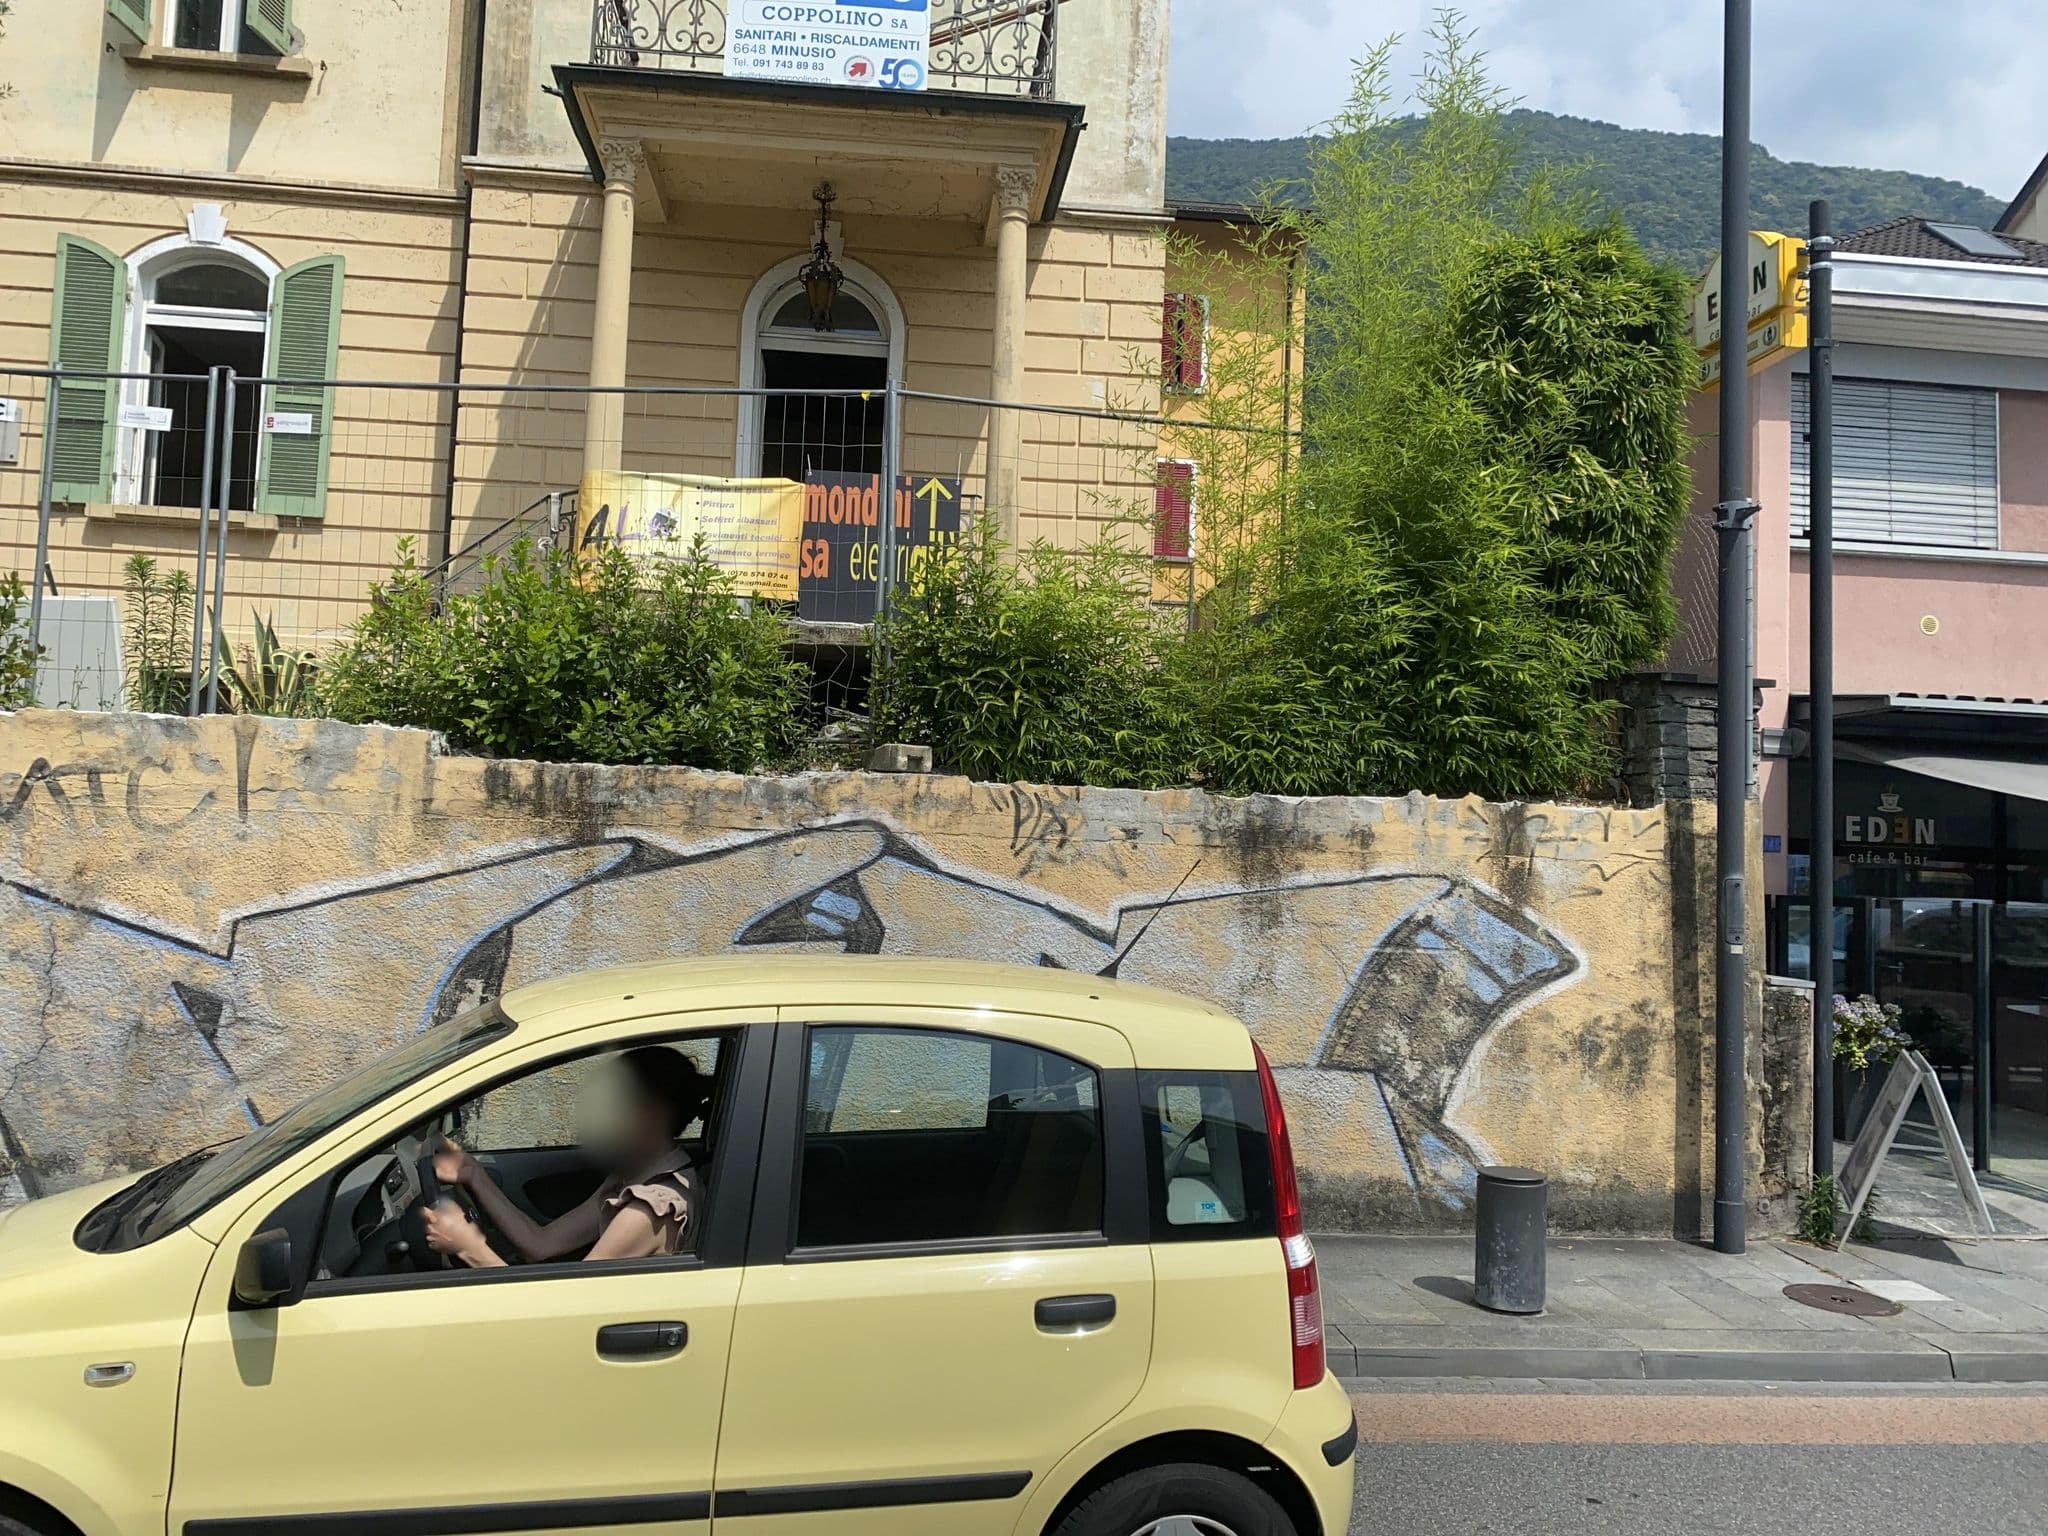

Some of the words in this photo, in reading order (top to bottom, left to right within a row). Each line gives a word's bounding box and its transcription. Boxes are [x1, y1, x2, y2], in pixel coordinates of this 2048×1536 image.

[761, 6, 883, 27] COPPOLINO
[890, 18, 909, 30] SA
[733, 43, 766, 55] 6648
[771, 44, 836, 59] MINUSIO
[734, 28, 797, 42] SANITARI
[810, 32, 920, 51] RISCALDAMENTI
[732, 57, 749, 67] Tel.
[752, 58, 770, 68] 091
[774, 60, 793, 69] 743
[1707, 260, 1767, 322] EN
[800, 539, 830, 579] sa
[1849, 850, 1881, 864] cafe
[1888, 852, 1897, 864] &
[1904, 852, 1929, 865] bar
